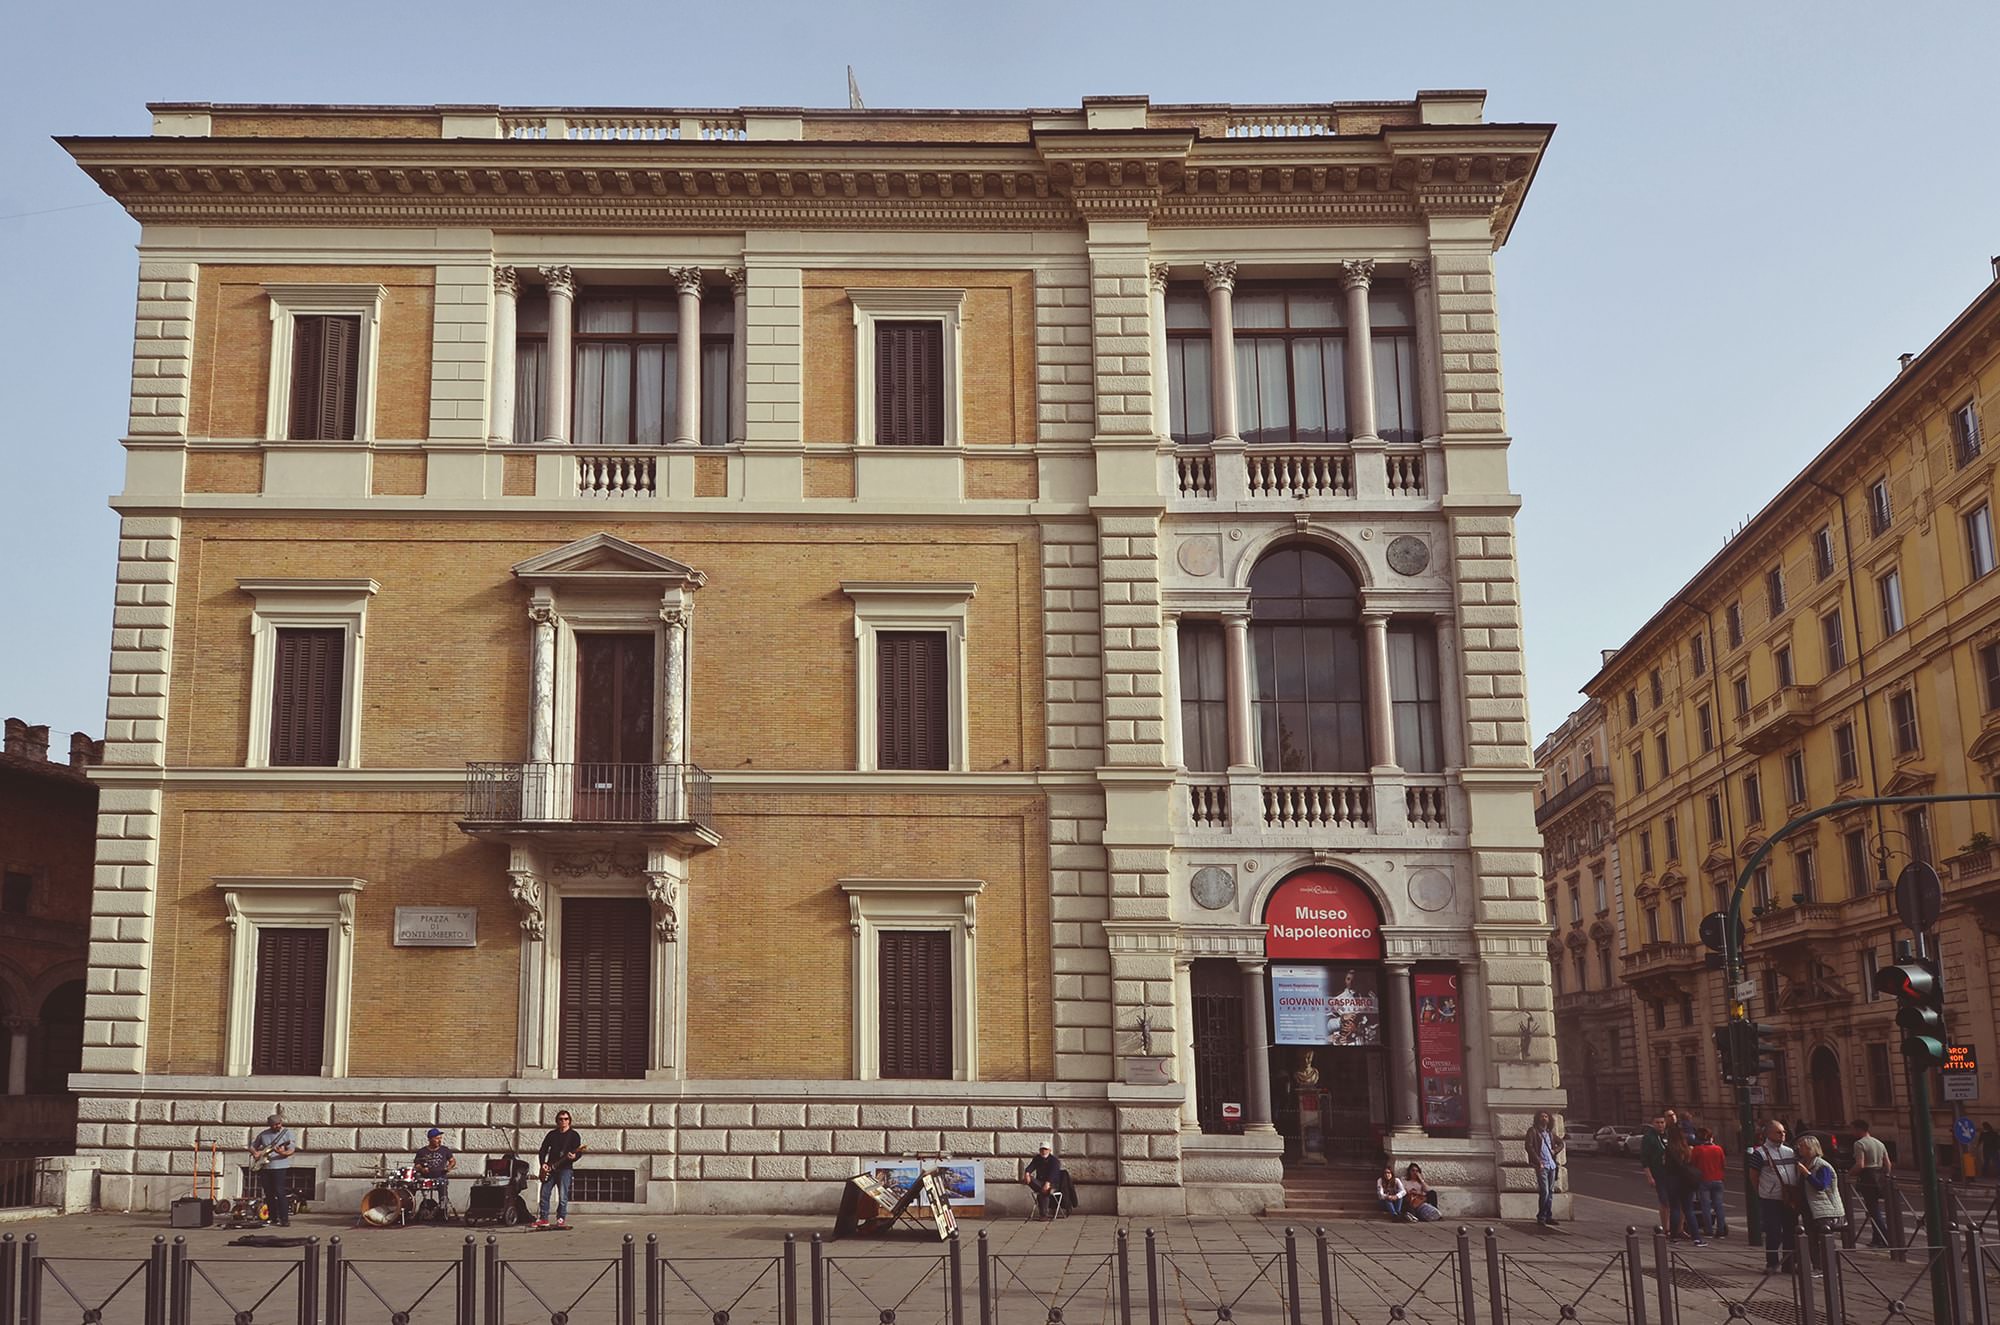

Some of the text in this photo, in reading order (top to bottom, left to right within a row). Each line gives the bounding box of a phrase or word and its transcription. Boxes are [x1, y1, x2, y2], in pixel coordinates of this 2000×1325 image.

[1295, 906, 1348, 920] Museo
[420, 915, 449, 923] PIAZZA
[400, 930, 426, 938] PONTE
[427, 930, 463, 938] UMBERTO
[1273, 924, 1372, 941] Napoleonico
[1279, 997, 1374, 1007] GIOVANNI GASPARRO
[1944, 1060, 1975, 1069] ATTIVO
